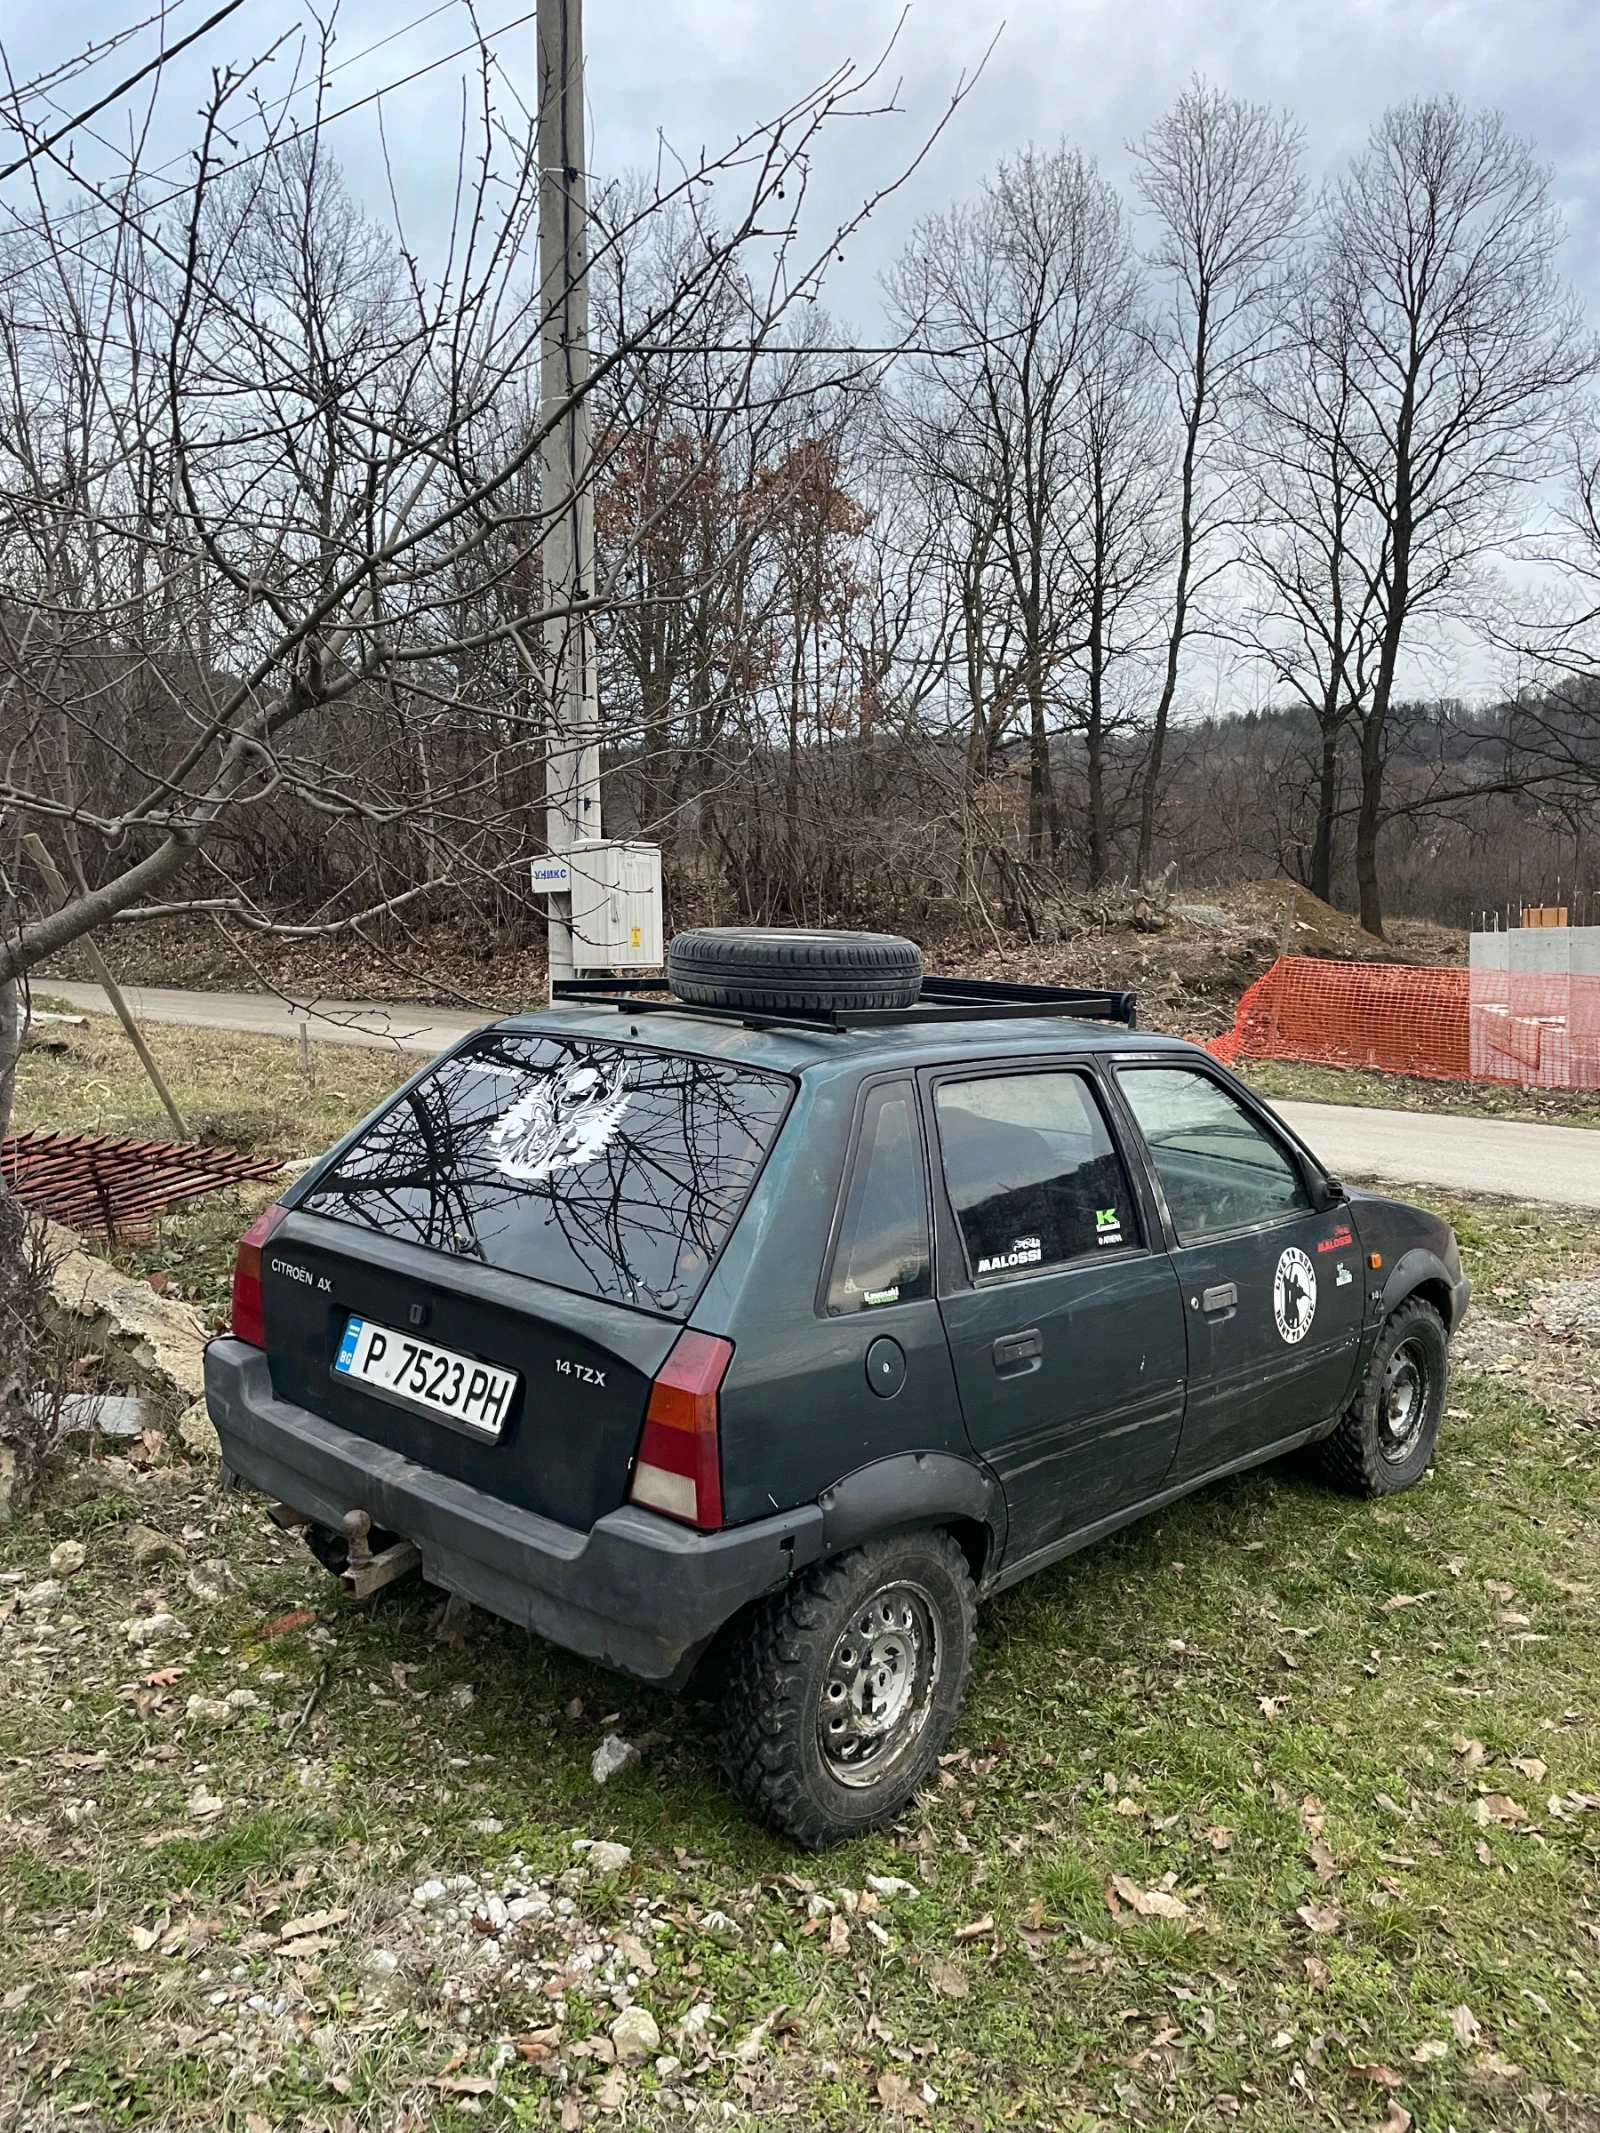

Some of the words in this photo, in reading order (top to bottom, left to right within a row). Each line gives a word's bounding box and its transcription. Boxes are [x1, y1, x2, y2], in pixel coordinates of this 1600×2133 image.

[534, 869, 567, 880] УНИКС
[1318, 1235, 1352, 1253] MALOSSI
[978, 1248, 1042, 1273] MALOSSI
[1285, 1249, 1296, 1261] TO
[271, 1258, 314, 1286] CITROËN
[317, 1277, 333, 1294] AX
[1291, 1329, 1301, 1341] TO
[340, 1350, 353, 1365] BG
[555, 1359, 572, 1375] 14
[574, 1363, 606, 1388] TZX
